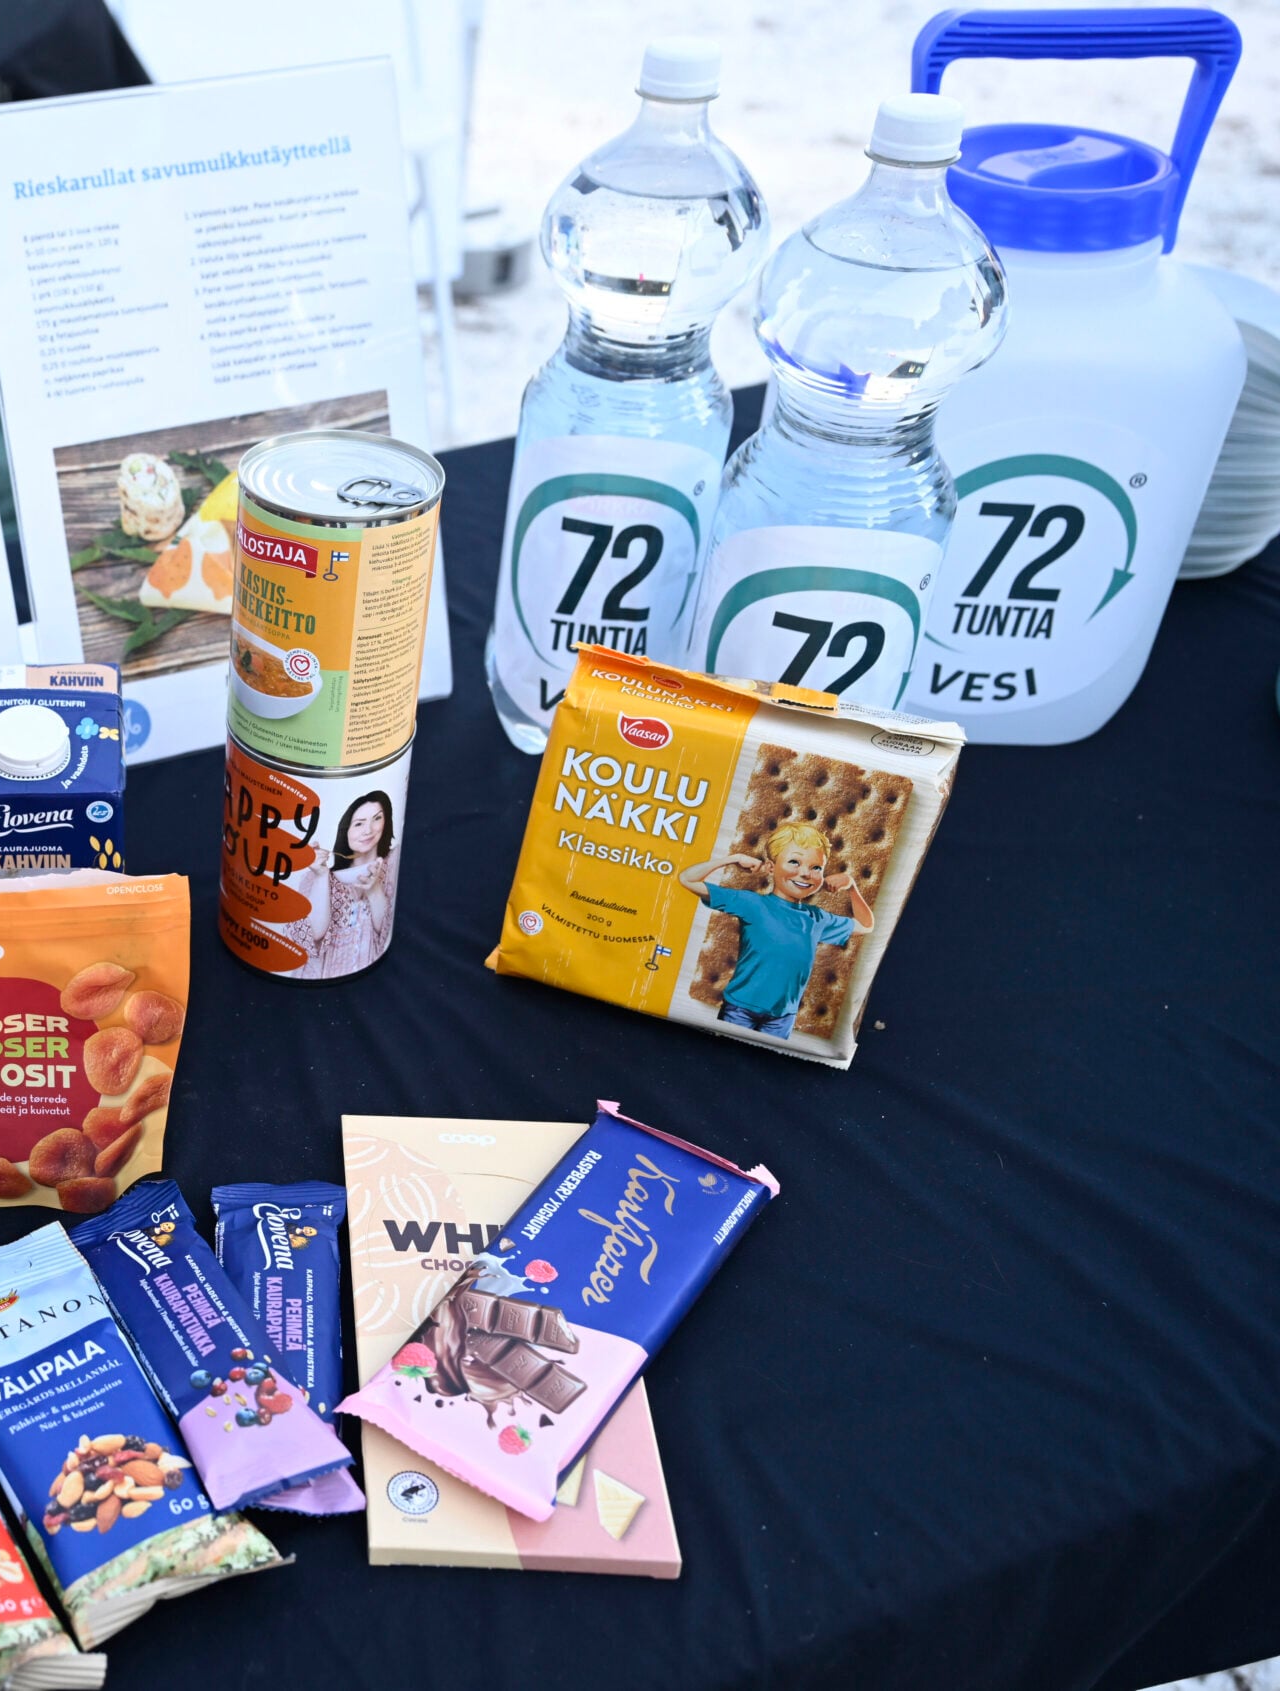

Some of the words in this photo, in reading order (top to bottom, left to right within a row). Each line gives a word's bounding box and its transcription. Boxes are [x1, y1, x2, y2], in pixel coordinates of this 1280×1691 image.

[14, 168, 135, 200] Rieskarullat
[141, 135, 352, 183] savumuikkutäytteellä
[556, 516, 664, 622] 72
[962, 502, 1085, 602] 72
[550, 618, 647, 656] TUNTIA
[951, 602, 1054, 640] TUNTIA
[772, 610, 885, 696] 72
[49, 675, 104, 687] KAHVIIN
[590, 669, 734, 713] KOULUNÄKKI
[620, 686, 695, 710] Klassikko
[929, 664, 1037, 701] VESI
[38, 699, 86, 709] GLUTENFRI
[622, 720, 666, 744] Vaasan
[71, 745, 89, 781] vaahdota
[561, 746, 709, 808] KOULU
[553, 781, 699, 845] NÄKKI
[558, 829, 674, 876] Klassikko
[106, 883, 165, 896] OPEN/CLOSE
[569, 890, 638, 916] Runsaskuituinen
[541, 903, 600, 939] VALMISTETTU
[603, 934, 656, 944] SUOMESSA
[14, 1095, 28, 1105] og
[29, 1094, 68, 1105] tørrede
[30, 1106, 71, 1116] kuivatut
[553, 1148, 603, 1203] RASPBERRY
[252, 1202, 302, 1271] Elovena
[519, 1191, 567, 1241] YOGHURT
[577, 1208, 658, 1307] Fazer
[153, 1272, 217, 1358] KAURAPATUKKA
[181, 1282, 227, 1329] PEHMEÄ
[285, 1298, 308, 1351] PEHMEÄ
[54, 1358, 124, 1395] MELLANMÅL
[306, 1347, 315, 1389] MUSTIKKA
[60, 1378, 123, 1412] marjasekoitus
[168, 1497, 194, 1515] 60
